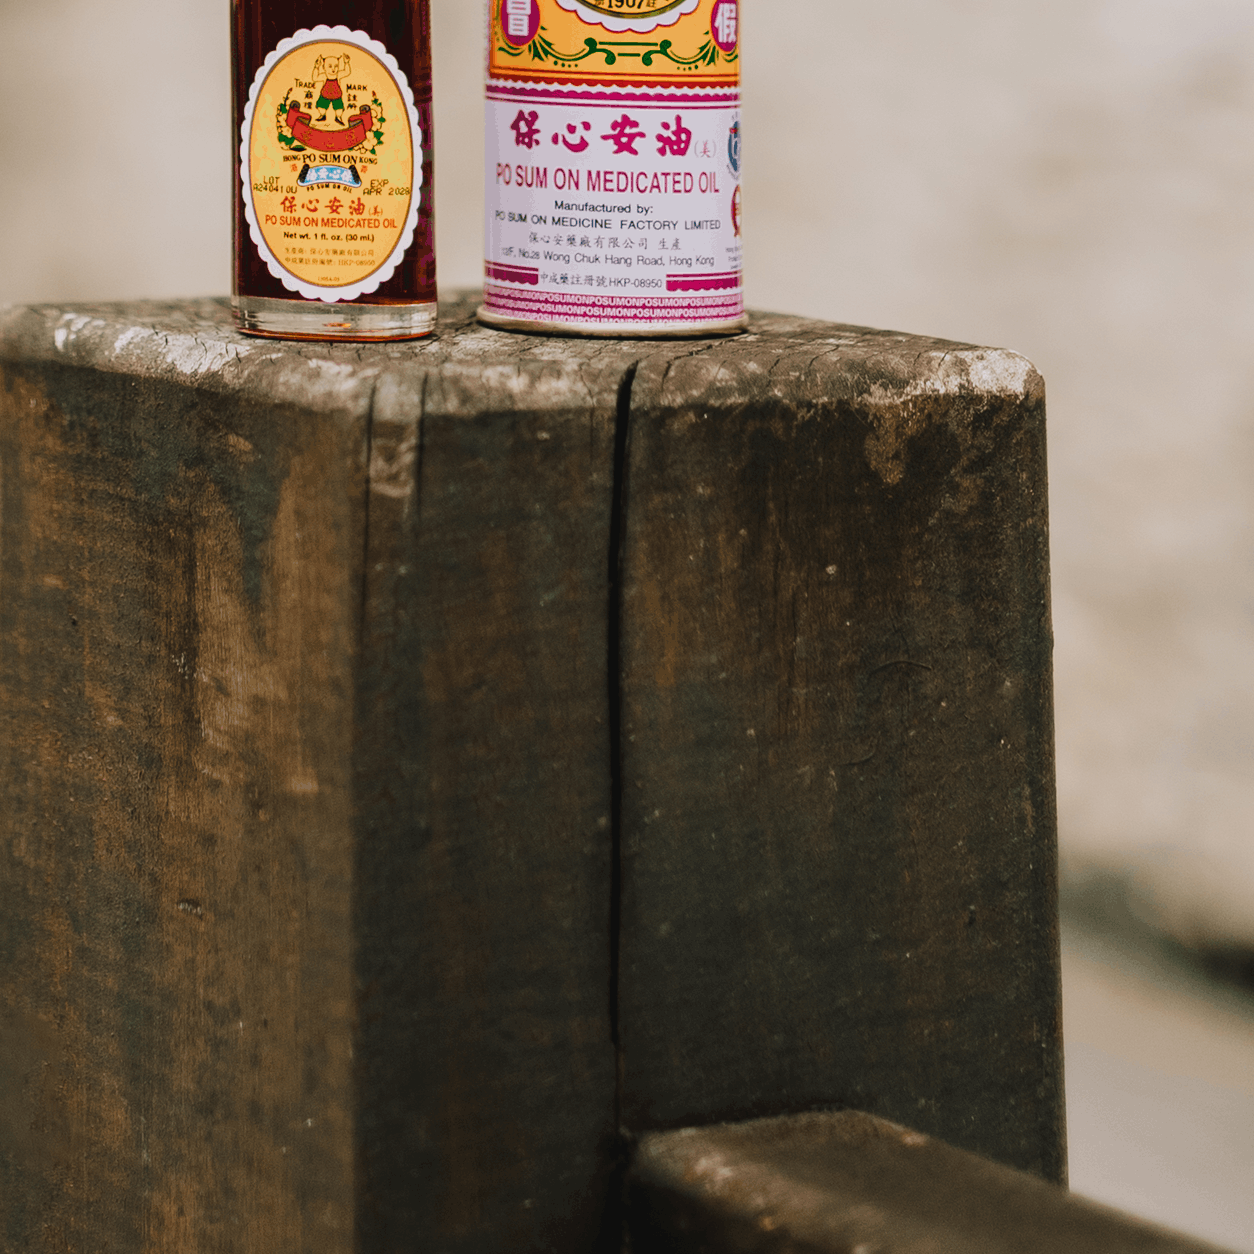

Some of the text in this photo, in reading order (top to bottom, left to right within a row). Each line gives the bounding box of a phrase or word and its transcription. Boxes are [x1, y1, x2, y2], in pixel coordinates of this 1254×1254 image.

[510, 109, 692, 157] 保心安油
[302, 153, 317, 163] PO
[319, 153, 341, 164] SUM
[342, 154, 358, 165] ON
[263, 175, 280, 185] LOT
[370, 178, 389, 188] EXP
[496, 162, 512, 186] PO
[515, 164, 548, 189] SUM
[553, 167, 580, 191] ON
[587, 170, 694, 194] MEDICATED
[698, 171, 720, 194] OIL
[362, 187, 383, 196] APR
[280, 196, 366, 216] 保心安油
[554, 199, 654, 217] Manufactured by:
[265, 214, 397, 229] PO SUM ON MEDICATED OIL
[508, 211, 528, 223] SUM
[531, 213, 548, 226] ON
[551, 216, 613, 229] MEDICINE
[620, 219, 679, 231] FACTORY
[684, 220, 721, 231] LIMITED
[283, 231, 297, 240] Net
[345, 234, 358, 243] (30
[543, 250, 571, 265] Wong
[574, 252, 601, 264] Chuk
[605, 254, 633, 268] Hang
[636, 254, 666, 267] Road,
[669, 255, 693, 268] Hong
[695, 254, 715, 267] Kong
